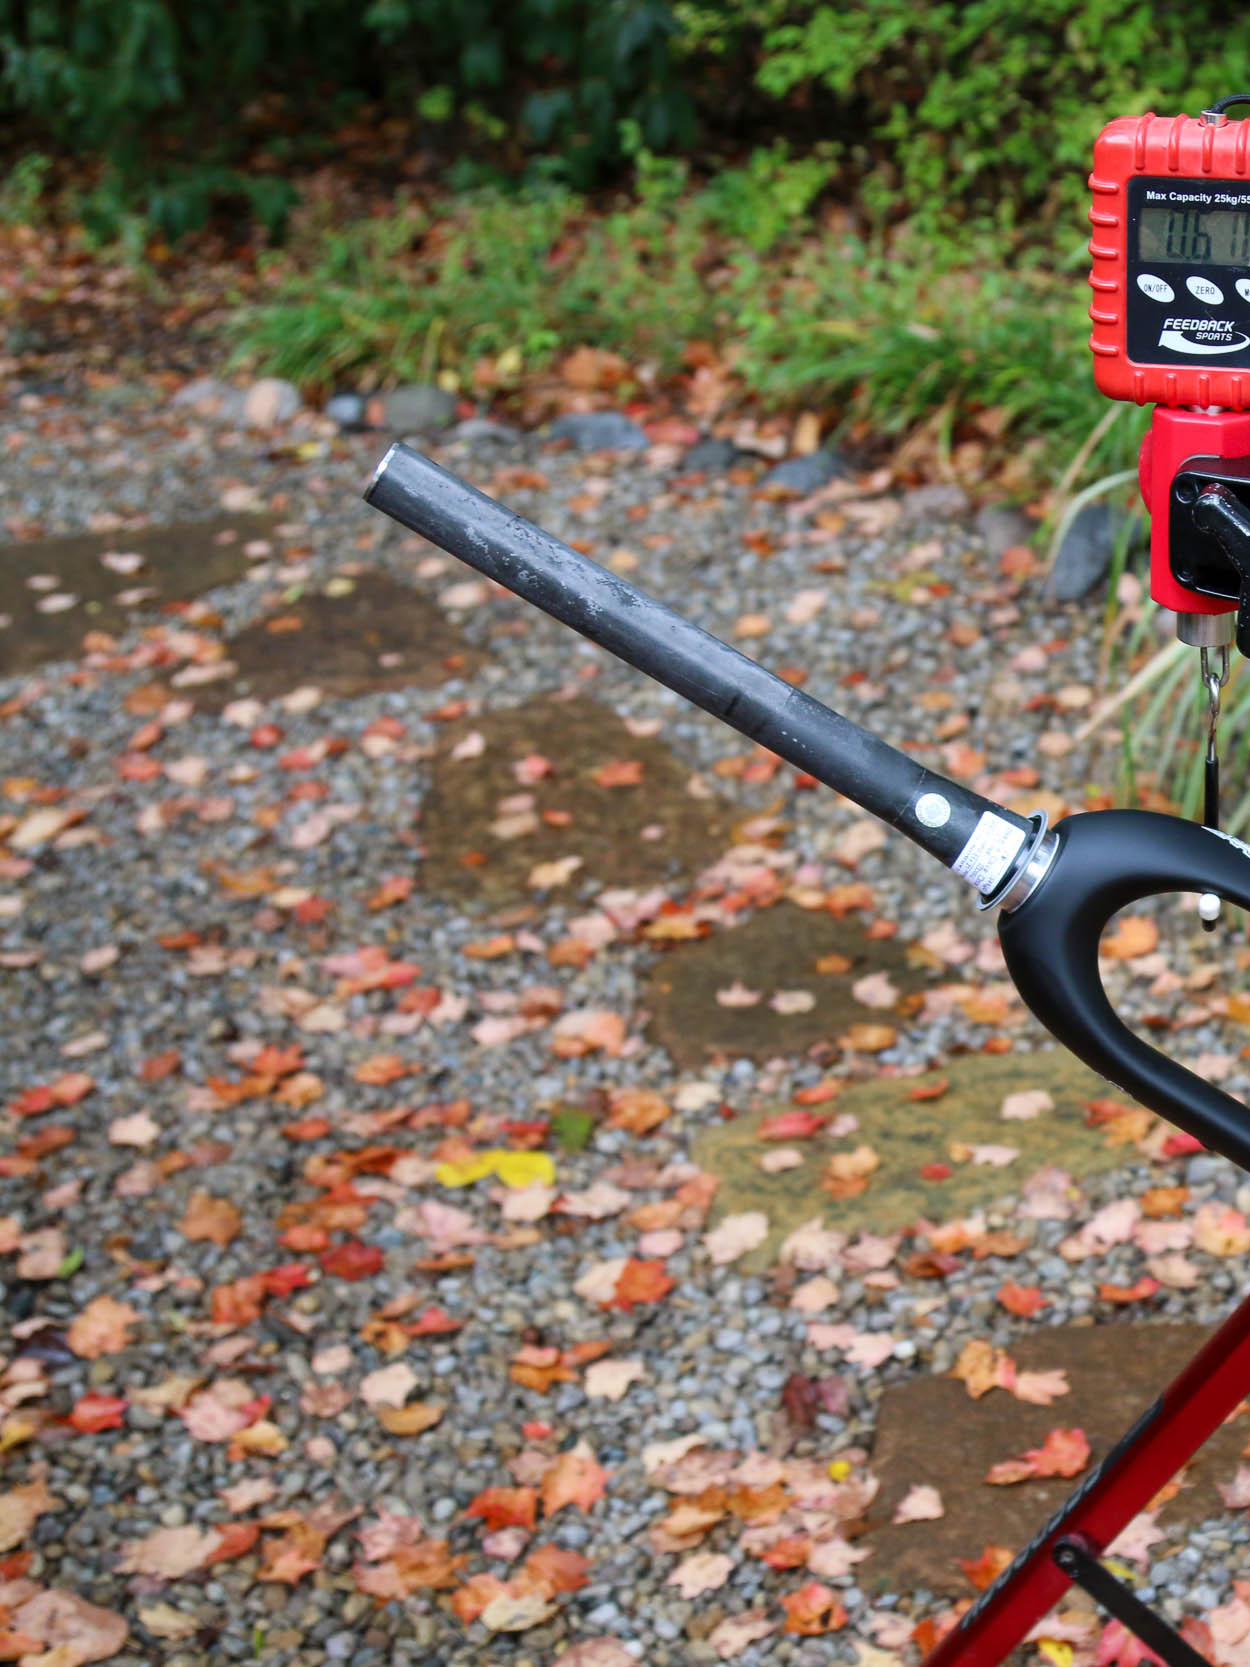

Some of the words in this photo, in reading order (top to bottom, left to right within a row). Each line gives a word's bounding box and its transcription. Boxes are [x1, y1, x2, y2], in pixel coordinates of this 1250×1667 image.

[1146, 191, 1167, 200] Max
[1169, 192, 1212, 204] Capacity
[1143, 284, 1168, 293] ON/OFF
[1195, 286, 1215, 295] ZERO
[1163, 318, 1235, 332] FEEDBACK
[1195, 332, 1233, 341] SPORTS
